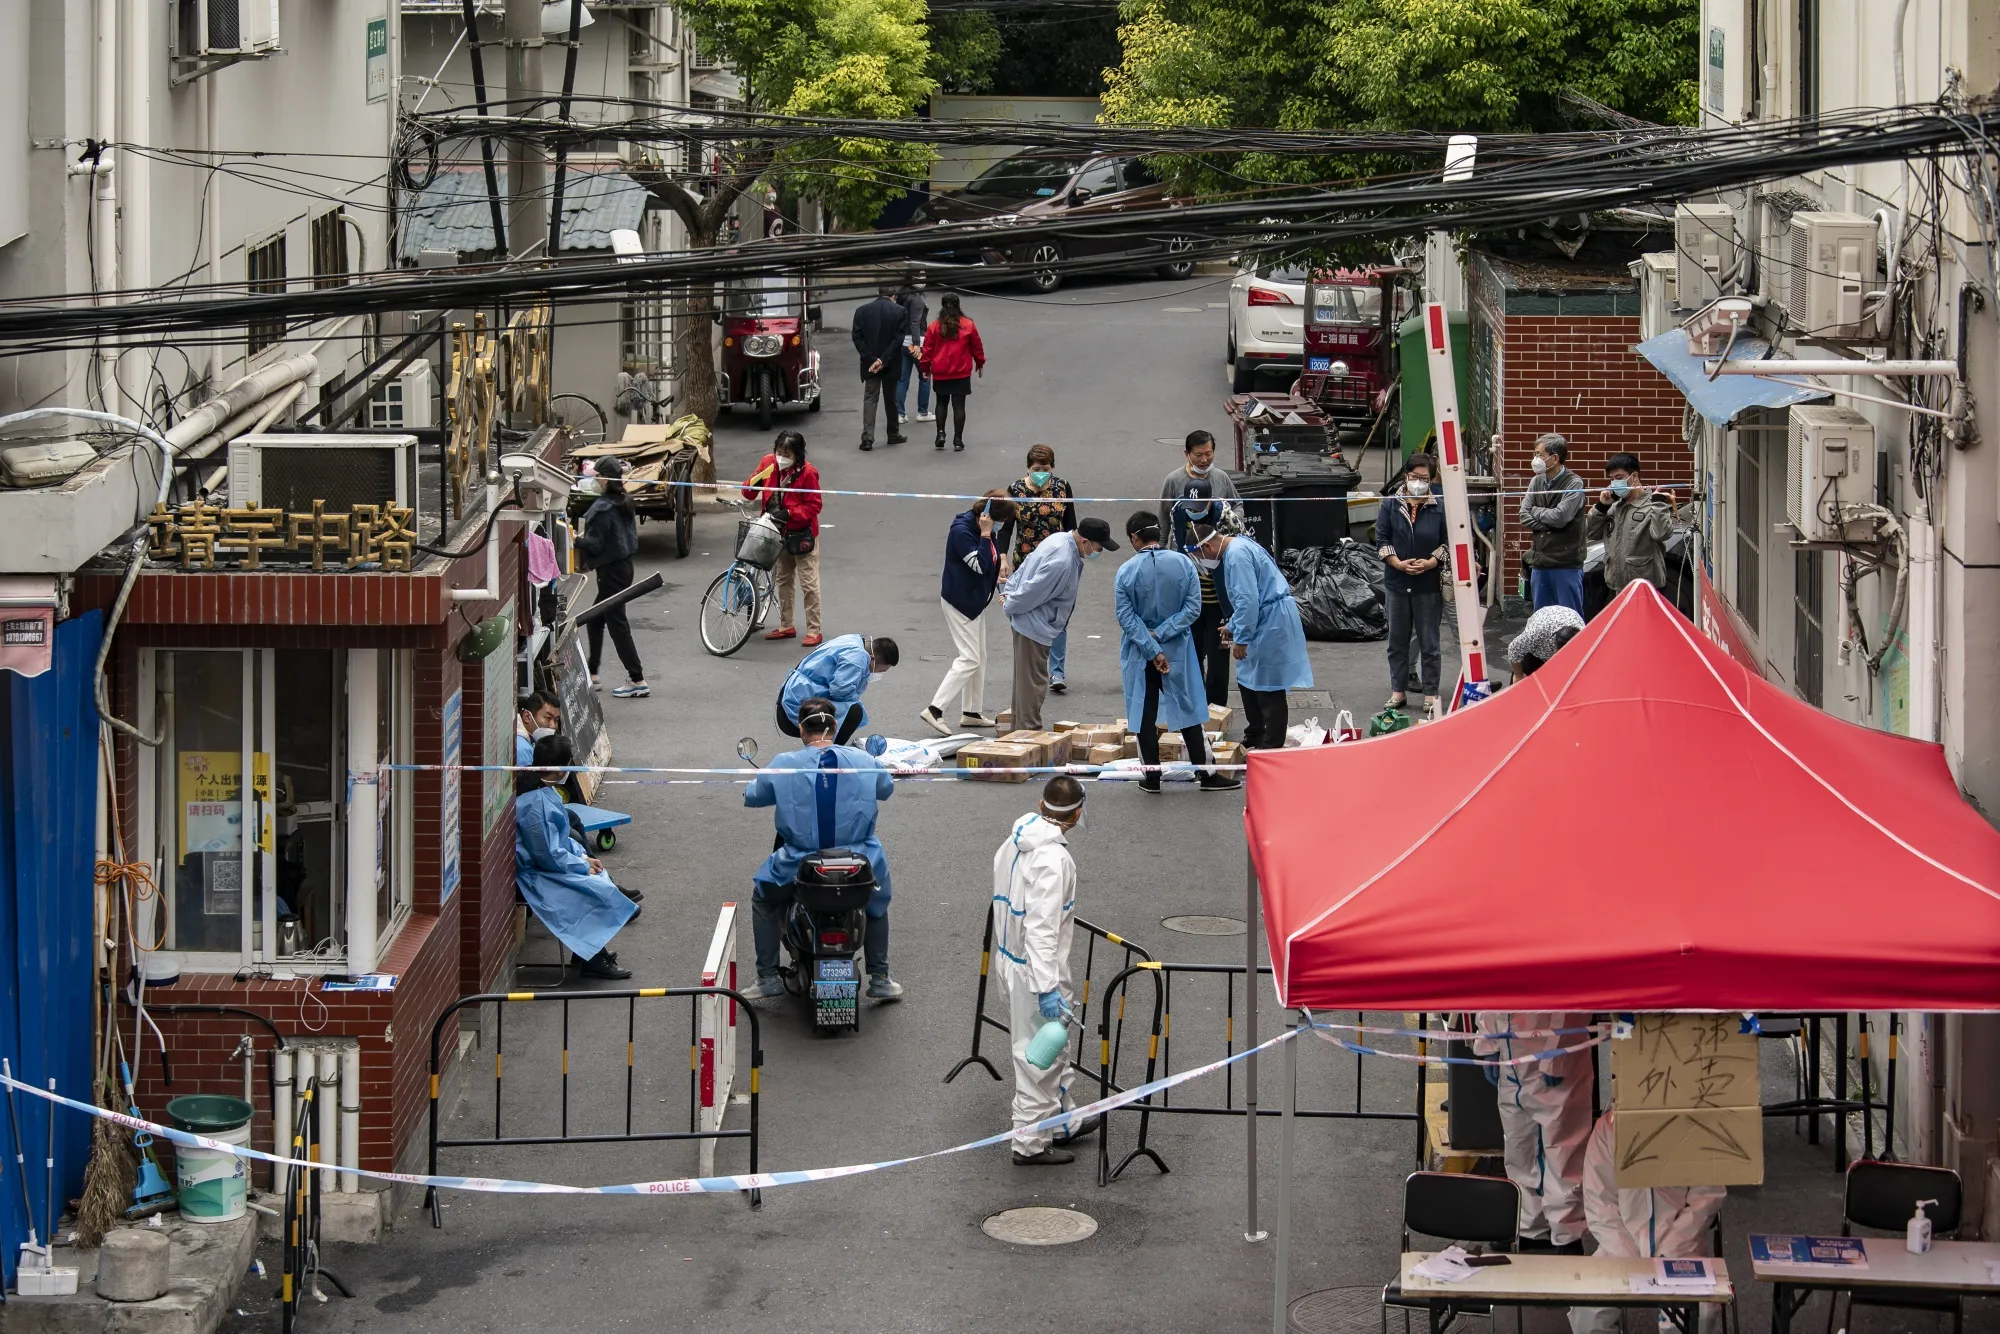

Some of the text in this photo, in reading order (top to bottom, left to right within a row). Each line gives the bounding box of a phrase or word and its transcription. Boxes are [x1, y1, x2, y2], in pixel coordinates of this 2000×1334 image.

[1189, 488, 1199, 499] NY
[147, 499, 418, 572] 靖宇中路
[196, 774, 267, 786] 个人出售源
[189, 804, 225, 816] 请扫码
[822, 968, 852, 977] C732963
[1637, 1058, 1737, 1112] 外卖
[112, 1113, 152, 1131] POLICE
[649, 1181, 691, 1193] POLICE
